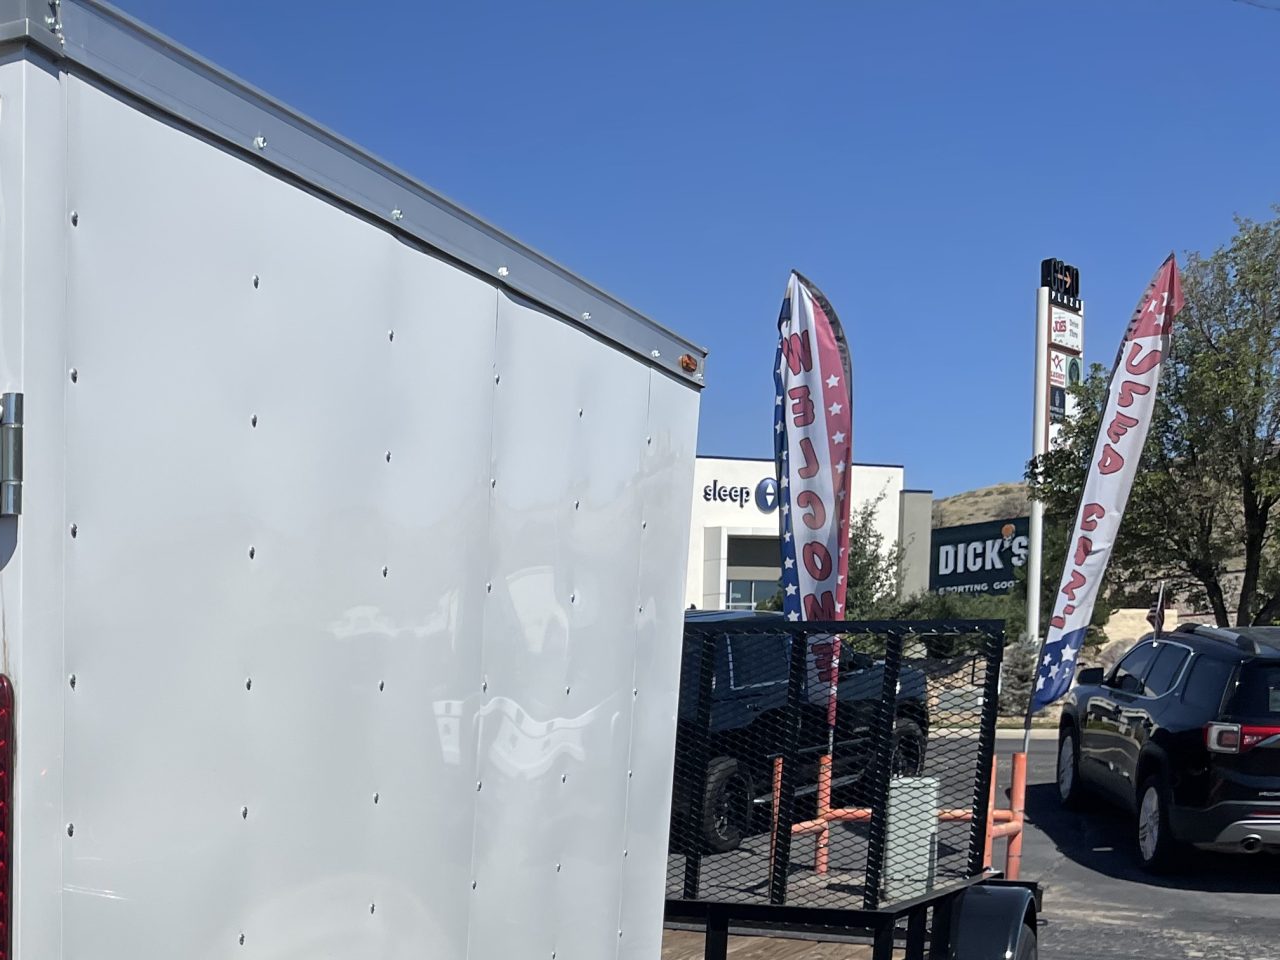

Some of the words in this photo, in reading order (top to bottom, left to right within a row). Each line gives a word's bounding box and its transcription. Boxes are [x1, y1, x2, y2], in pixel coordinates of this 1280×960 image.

[1051, 290, 1079, 308] PLAZA
[703, 479, 751, 509] sleep
[939, 536, 1029, 575] DICK'S
